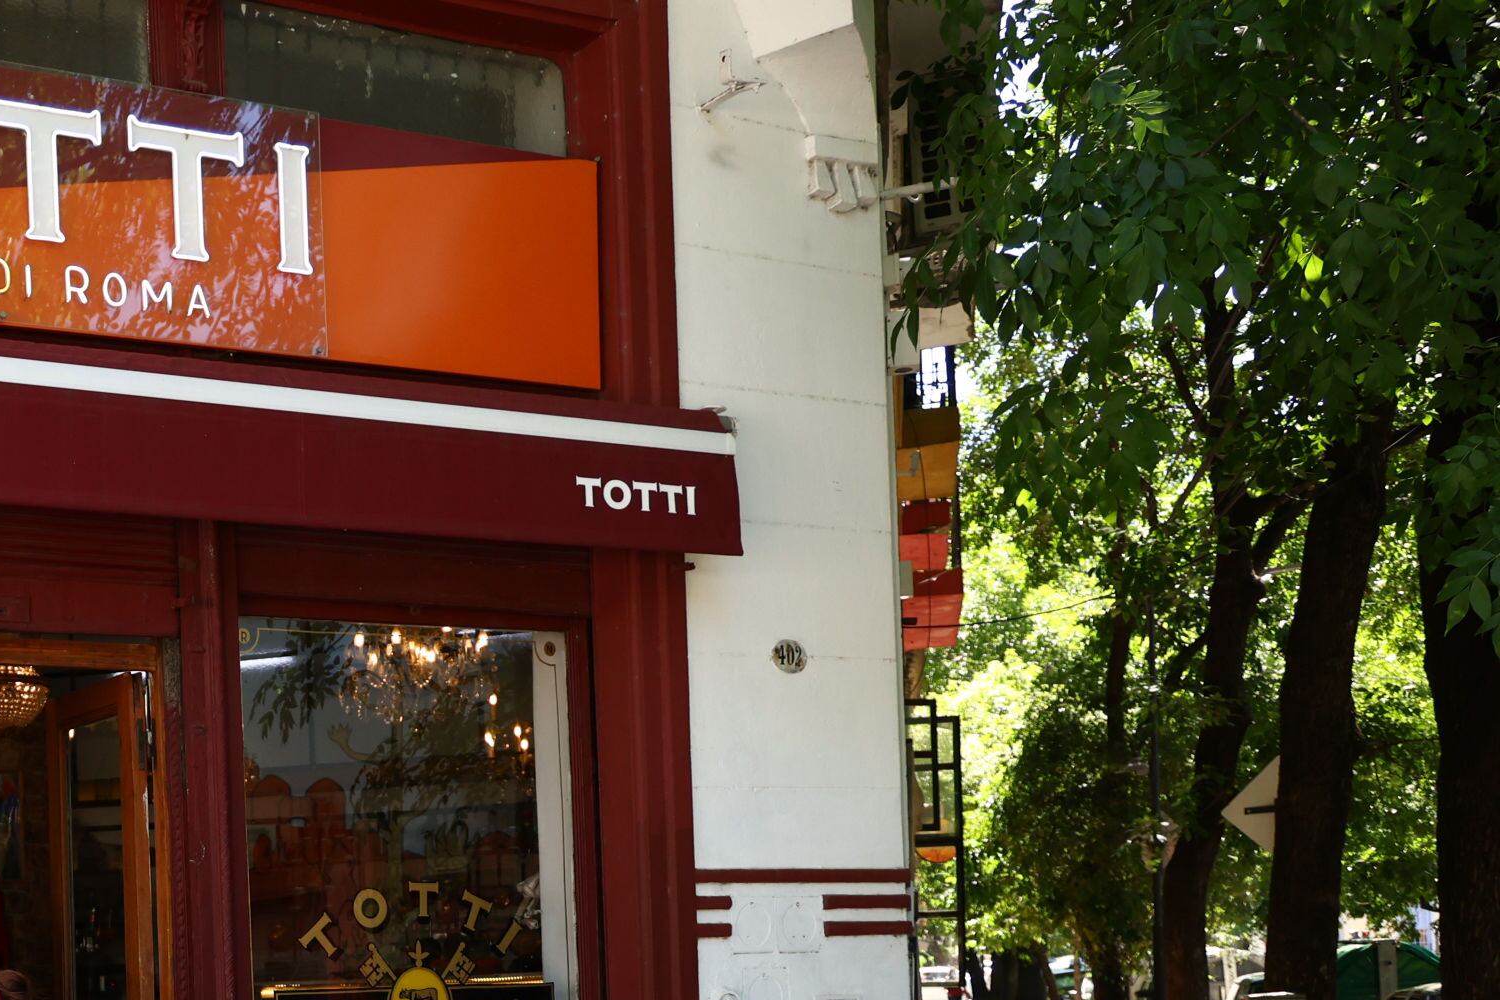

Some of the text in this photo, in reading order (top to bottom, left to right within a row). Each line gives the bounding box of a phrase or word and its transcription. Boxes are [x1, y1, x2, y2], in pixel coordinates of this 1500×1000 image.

[65, 265, 212, 319] ROMA
[575, 475, 697, 516] TOTTI
[777, 643, 804, 667] 402
[298, 880, 522, 959] TOTTI
